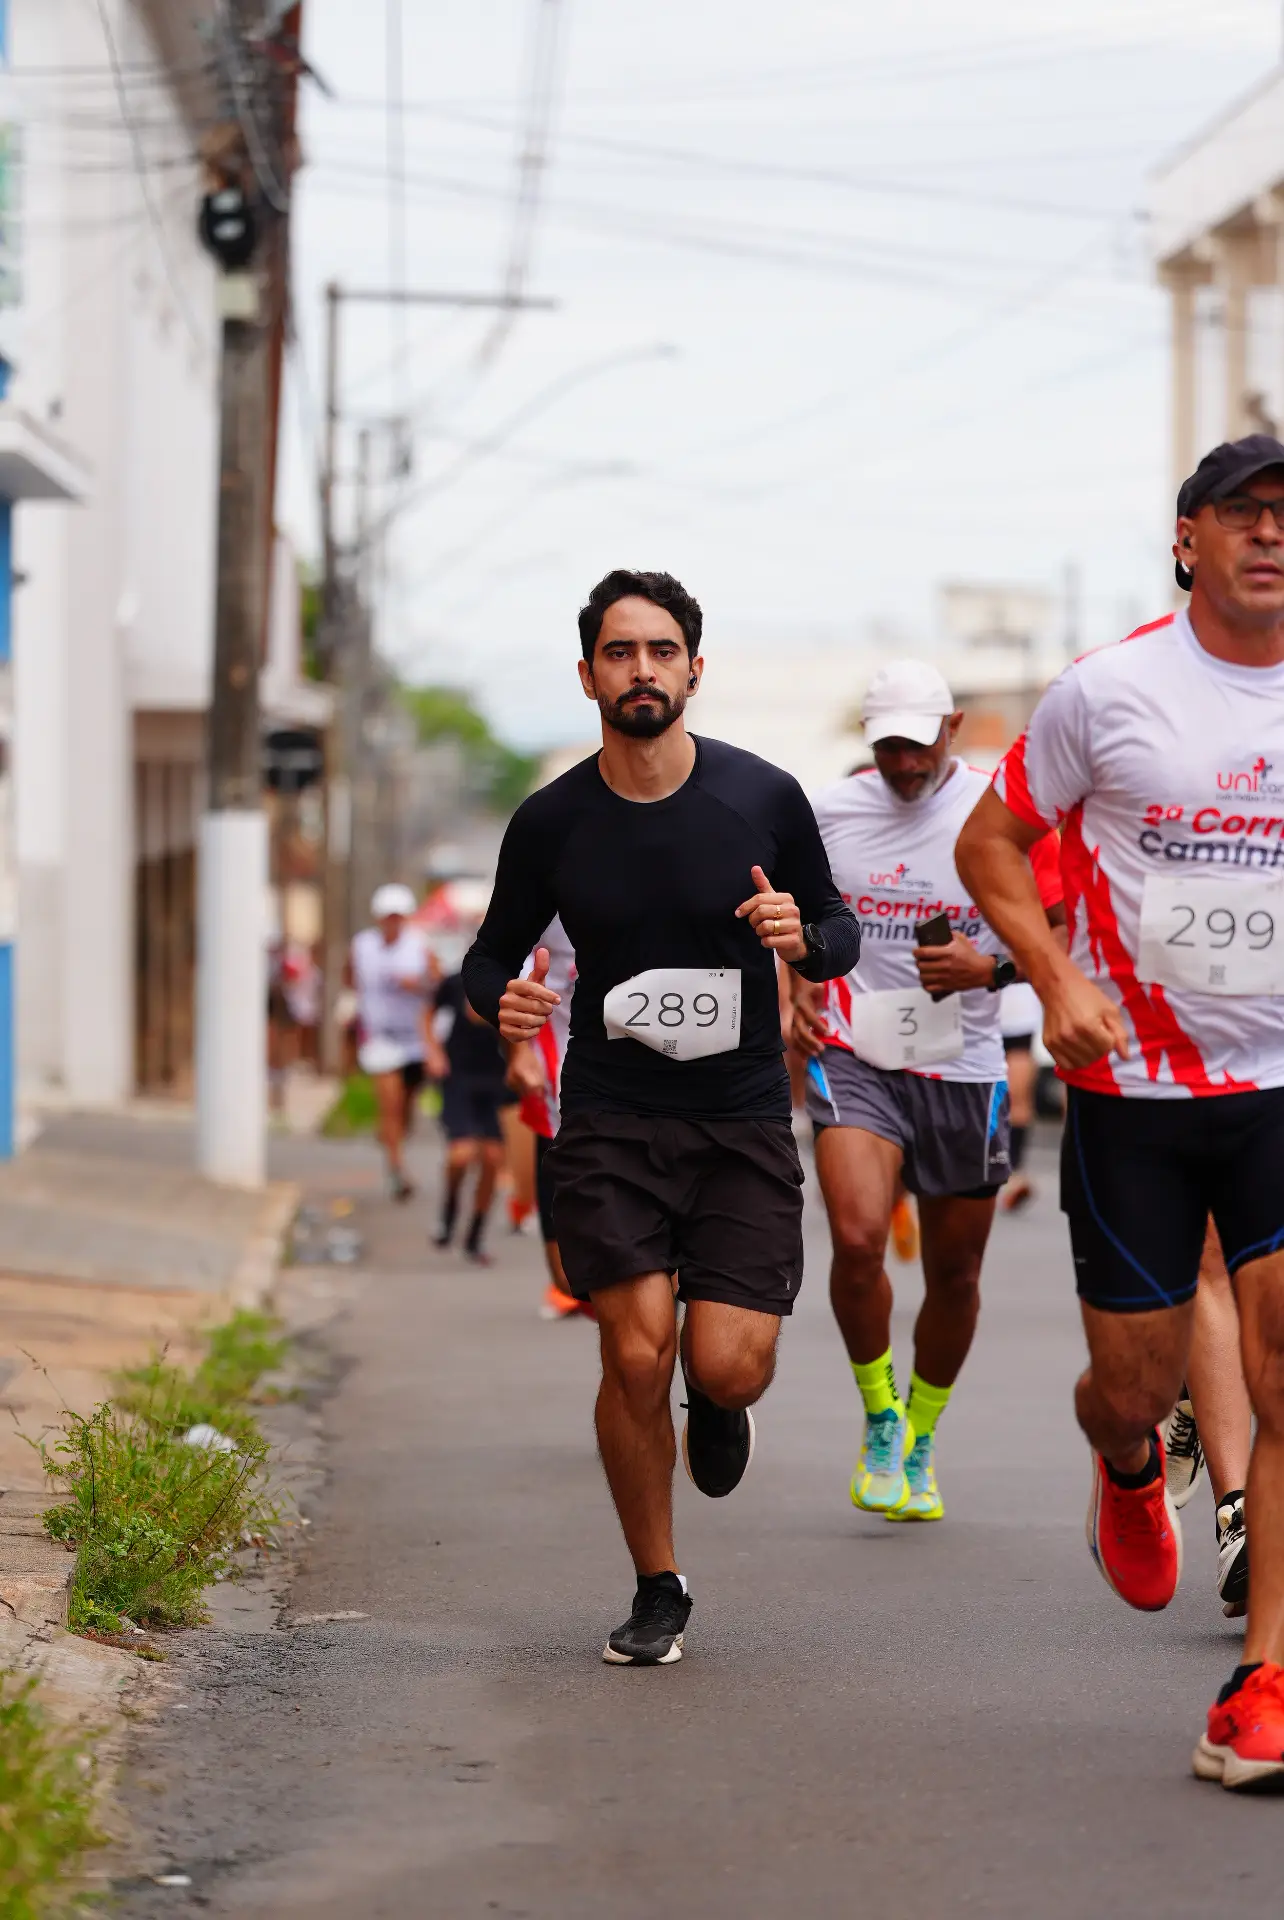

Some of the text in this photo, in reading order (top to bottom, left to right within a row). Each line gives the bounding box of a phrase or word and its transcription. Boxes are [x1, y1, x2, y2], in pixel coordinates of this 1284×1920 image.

[1165, 906, 1275, 951] 299
[624, 992, 719, 1028] 289
[897, 1006, 918, 1036] 3
